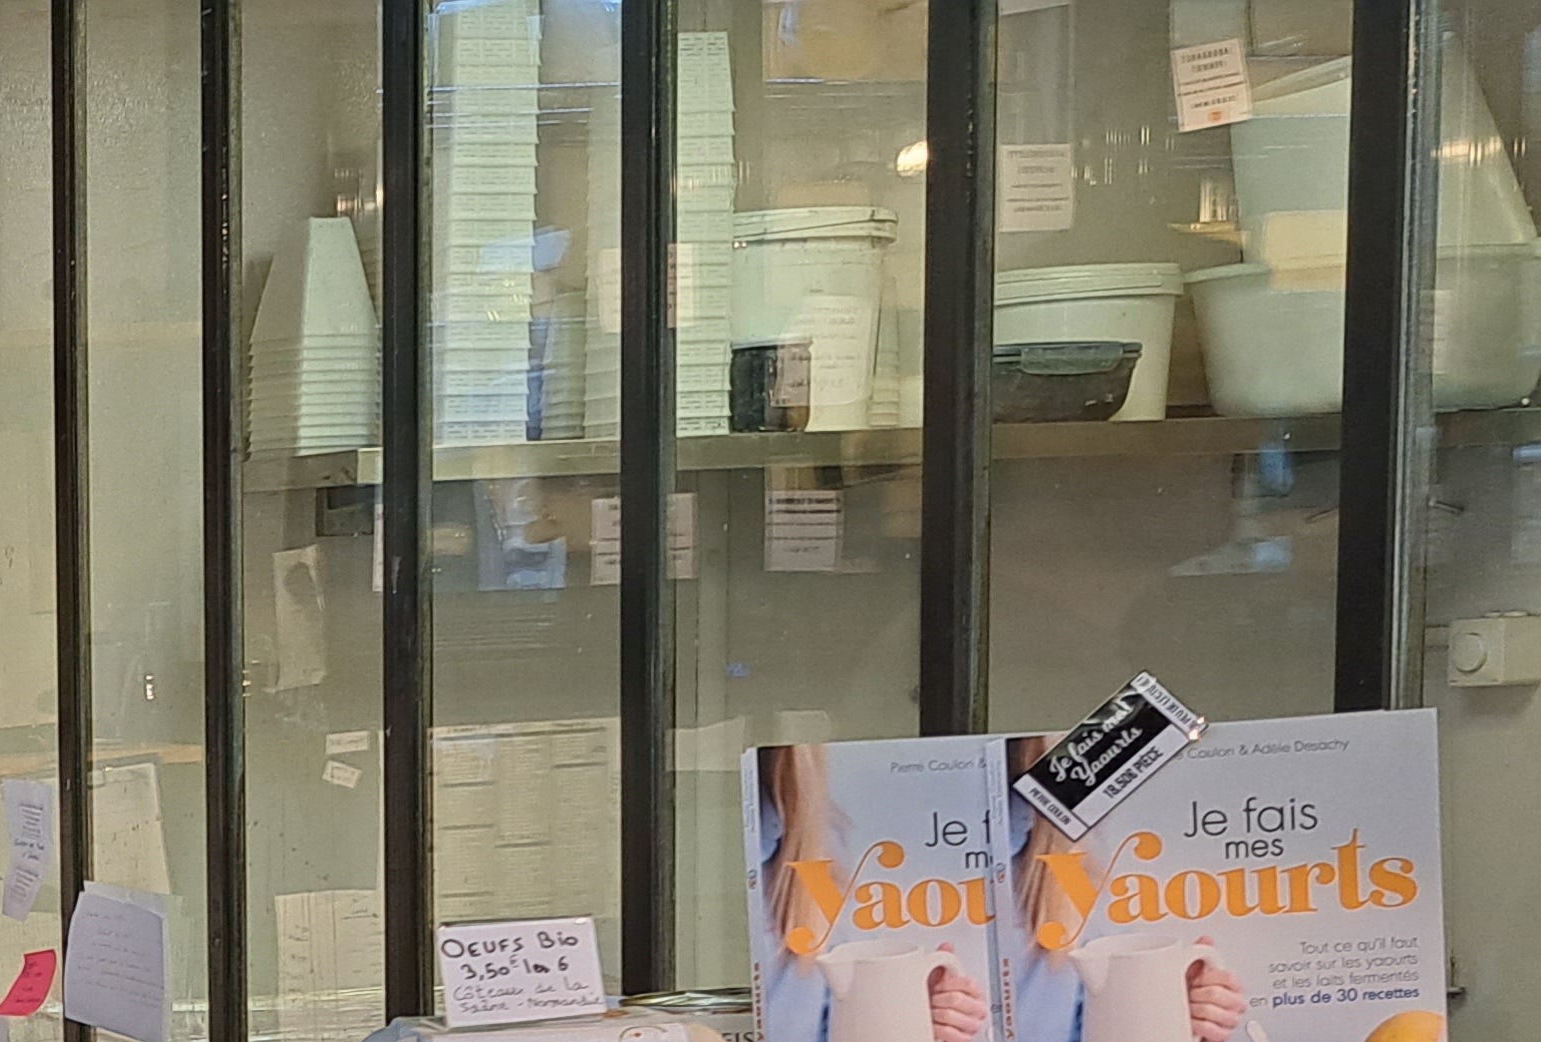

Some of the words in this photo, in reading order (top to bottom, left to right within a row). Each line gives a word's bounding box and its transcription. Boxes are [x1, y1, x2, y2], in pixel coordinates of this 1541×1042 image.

[1070, 725, 1144, 787] Yaourts
[1183, 800, 1229, 839] Je
[1242, 796, 1319, 835] fais
[924, 811, 968, 848] Je
[1224, 838, 1285, 860] mes
[440, 933, 524, 960] OEUFS
[538, 930, 579, 949] Bio
[1300, 941, 1329, 955] Tout
[1333, 942, 1353, 953] ce
[1391, 936, 1419, 949] faut
[557, 956, 569, 973] 6
[1268, 961, 1312, 974] savoir
[1316, 960, 1337, 971] sur
[1341, 957, 1362, 969] les
[1366, 953, 1419, 970] yaourts
[1272, 979, 1289, 990] et
[1291, 977, 1312, 989] les
[1349, 968, 1420, 985] fermentés
[1249, 996, 1268, 1008] en
[1272, 993, 1305, 1010] plus
[1310, 990, 1332, 1005] de
[1337, 988, 1359, 1002] 30
[1362, 987, 1421, 1002] recettes
